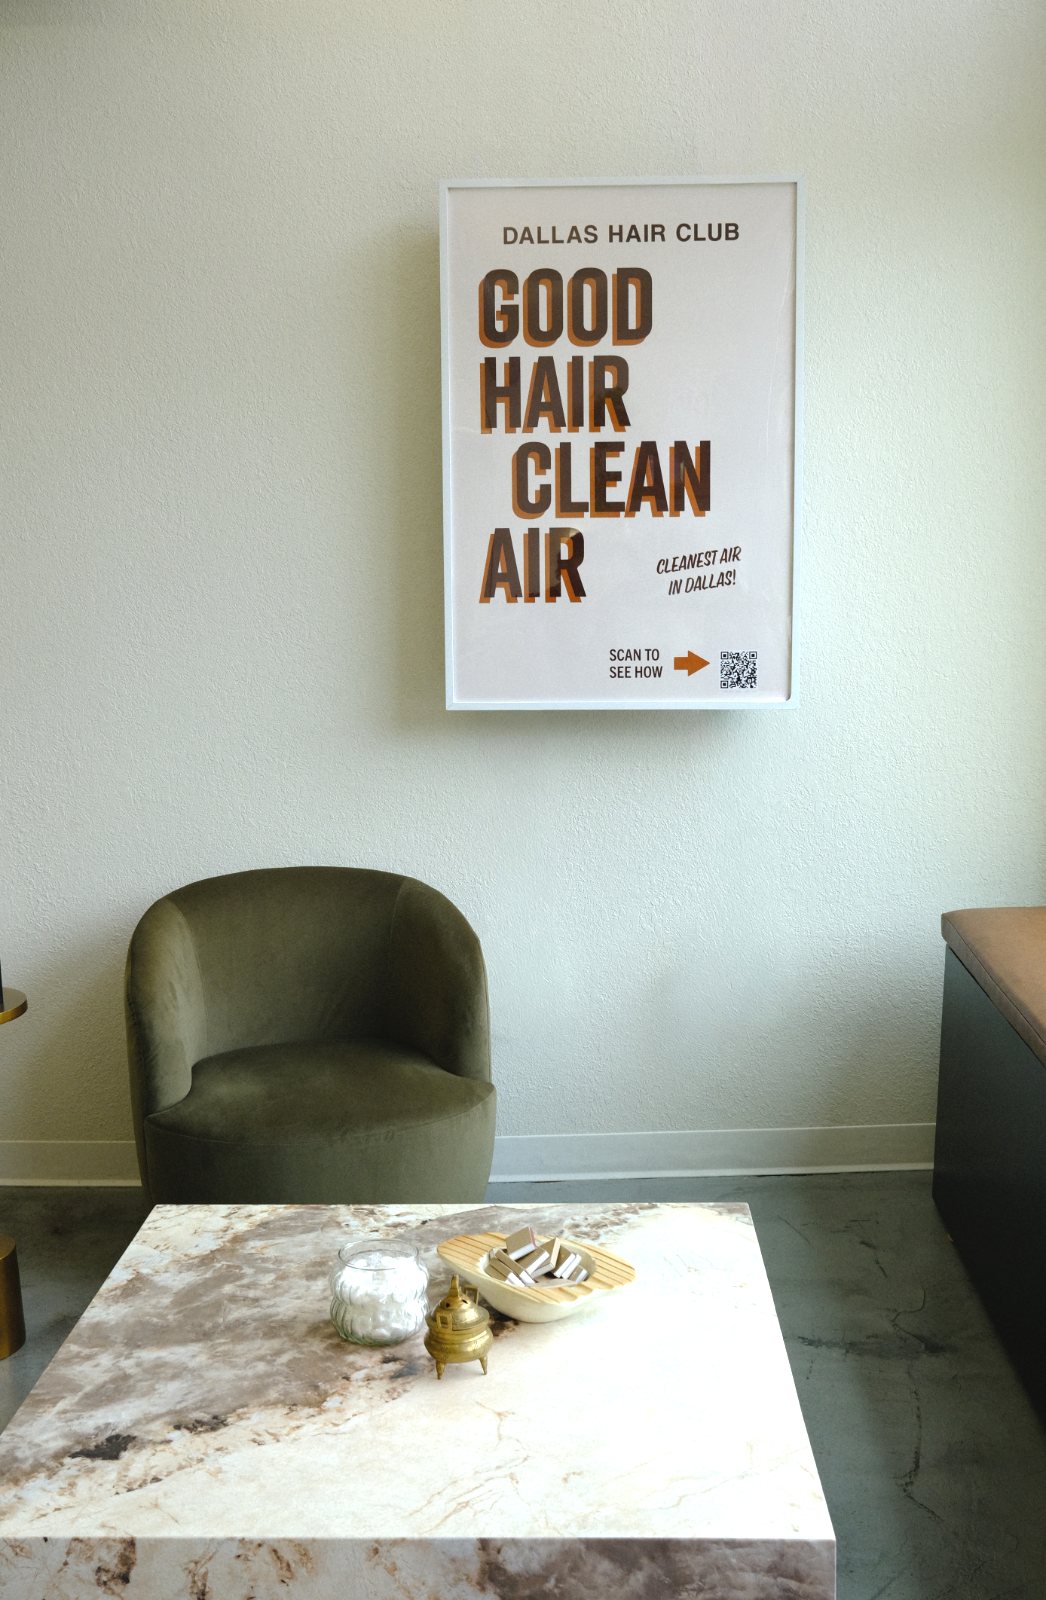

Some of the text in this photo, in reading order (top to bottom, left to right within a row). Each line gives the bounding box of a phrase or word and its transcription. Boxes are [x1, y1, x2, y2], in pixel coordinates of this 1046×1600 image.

[503, 222, 740, 245] DALLAS HAIR CLUB
[478, 267, 653, 348] GOOD
[479, 355, 631, 434] HAIR
[512, 440, 711, 520] CLEAN
[479, 527, 587, 603] AIR
[656, 546, 742, 574] CLEANEST AIR
[668, 569, 736, 595] IN DALLAS!
[609, 648, 660, 661] SCAN TO
[609, 665, 663, 678] SEE HOW
